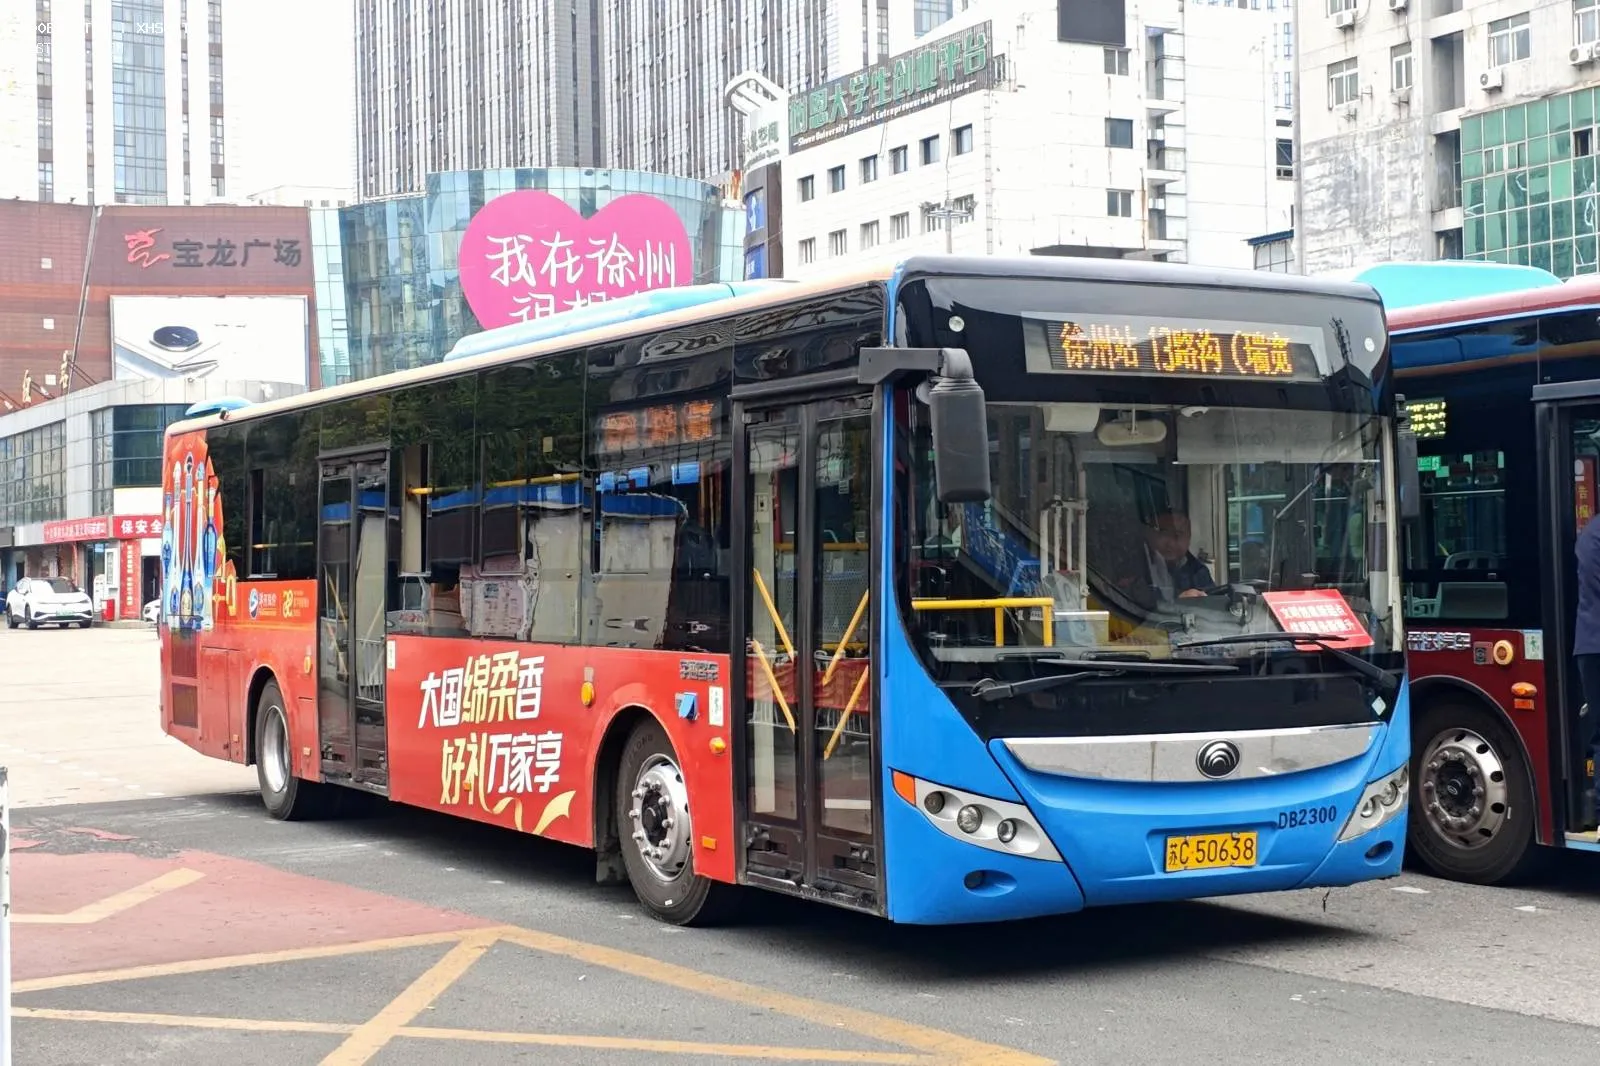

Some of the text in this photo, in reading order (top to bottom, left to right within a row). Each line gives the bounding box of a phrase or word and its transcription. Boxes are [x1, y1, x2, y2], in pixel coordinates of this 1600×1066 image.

[172, 239, 301, 268] 宝龙广场
[485, 231, 676, 289] 我在徐州
[121, 520, 162, 535] 保安全
[418, 651, 544, 729] 大国绵柔香
[440, 731, 563, 805] 好礼万家享
[1278, 806, 1337, 829] DB2300
